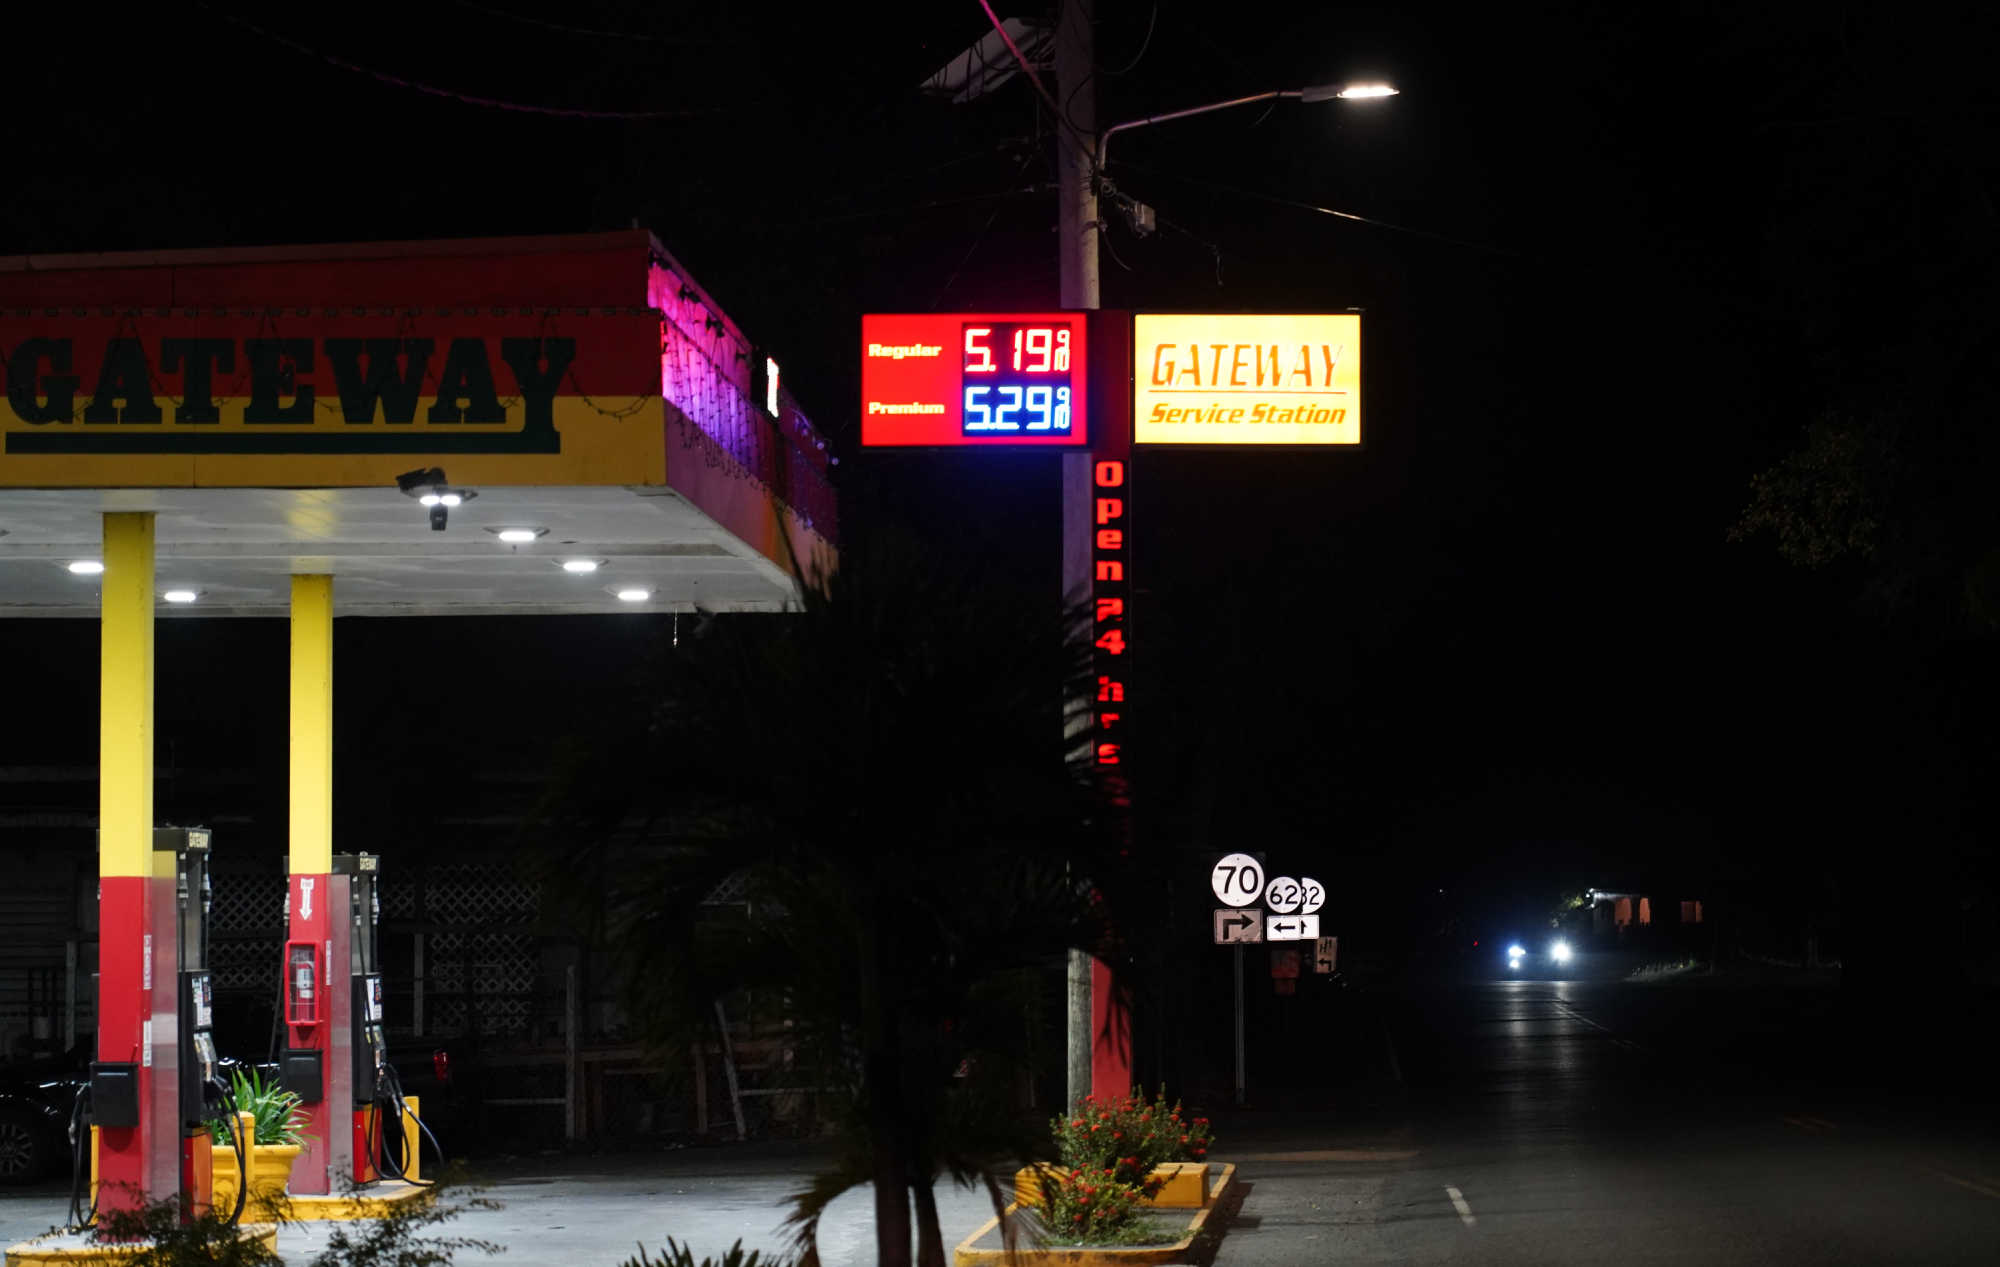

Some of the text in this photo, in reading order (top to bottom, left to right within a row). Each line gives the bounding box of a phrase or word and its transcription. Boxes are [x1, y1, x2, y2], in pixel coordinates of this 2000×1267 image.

[868, 343, 942, 359] Regular
[1151, 344, 1344, 387] GATEWAY
[6, 337, 576, 454] GATEWAY
[868, 402, 944, 414] Premium
[1149, 403, 1347, 424] Service Station
[1218, 866, 1258, 894] 70
[1270, 885, 1298, 905] 62
